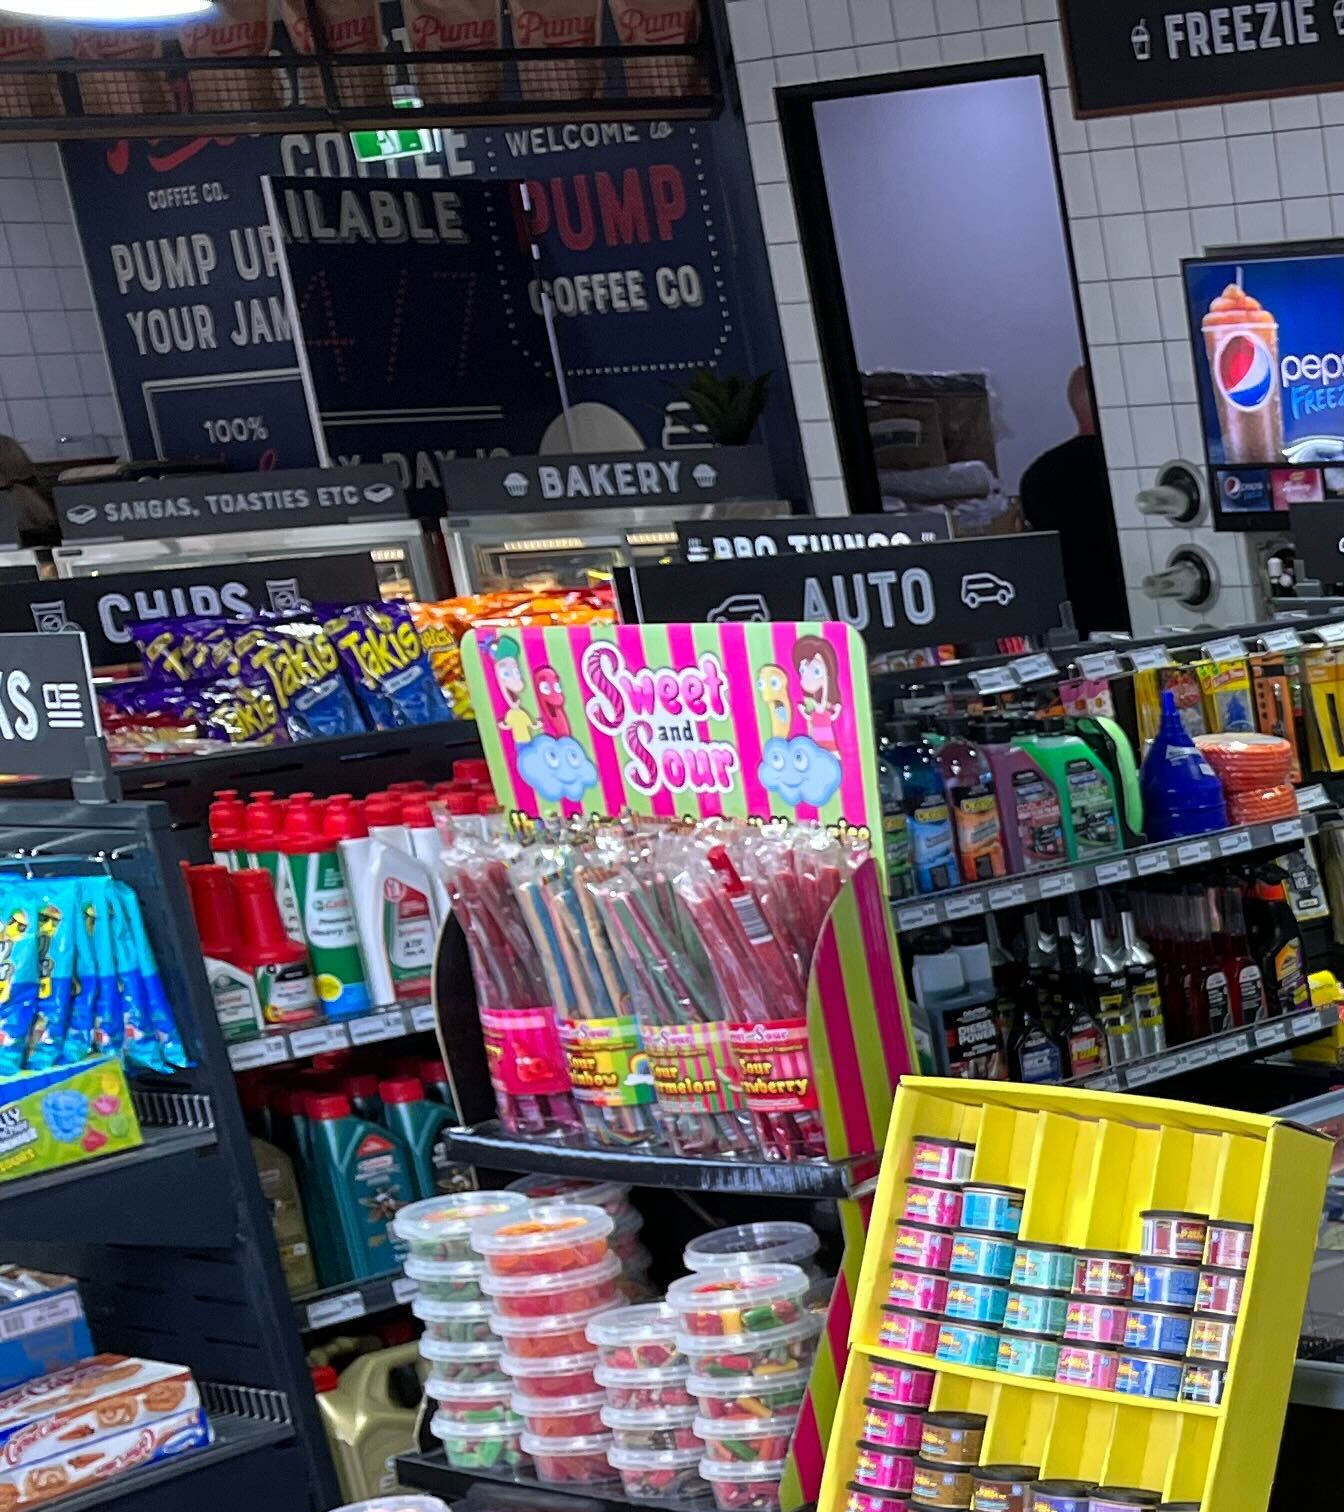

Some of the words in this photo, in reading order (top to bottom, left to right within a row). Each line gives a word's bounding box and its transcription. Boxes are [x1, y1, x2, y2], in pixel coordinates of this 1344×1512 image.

[1165, 0, 1319, 59] FREEZIE
[505, 123, 640, 157] WELCOME
[147, 183, 199, 211] COFFEE
[515, 164, 688, 252] PUMP
[111, 233, 217, 295] PUMP
[229, 225, 283, 281] UP
[528, 270, 645, 319] COFFEE
[655, 264, 701, 308] CO
[126, 304, 217, 356] YOUR
[231, 295, 294, 346] JAM
[203, 415, 269, 444] 100%
[206, 488, 309, 514] TOASTIES
[317, 485, 360, 507] ETC
[538, 461, 682, 499] BAKERY
[802, 567, 936, 632] AUTO
[584, 642, 728, 732] Sweet
[626, 724, 738, 792] Sour
[658, 721, 695, 743] and
